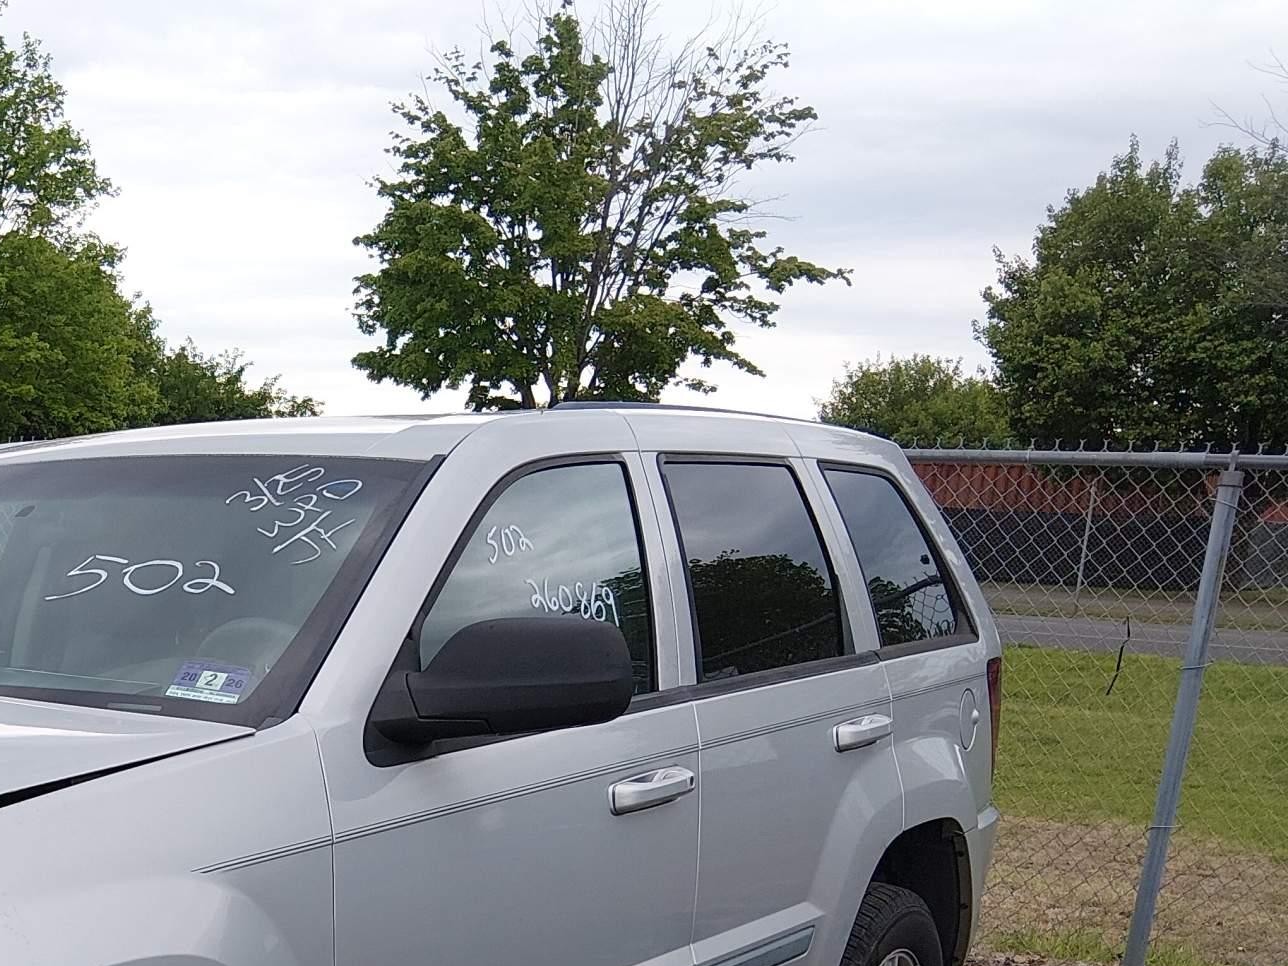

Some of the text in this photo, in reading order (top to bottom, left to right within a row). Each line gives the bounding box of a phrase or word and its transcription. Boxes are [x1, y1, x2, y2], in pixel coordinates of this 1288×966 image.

[486, 524, 534, 564] 502
[45, 554, 235, 600] 502
[524, 578, 620, 628] 260869
[181, 671, 244, 688] 20 2 26
